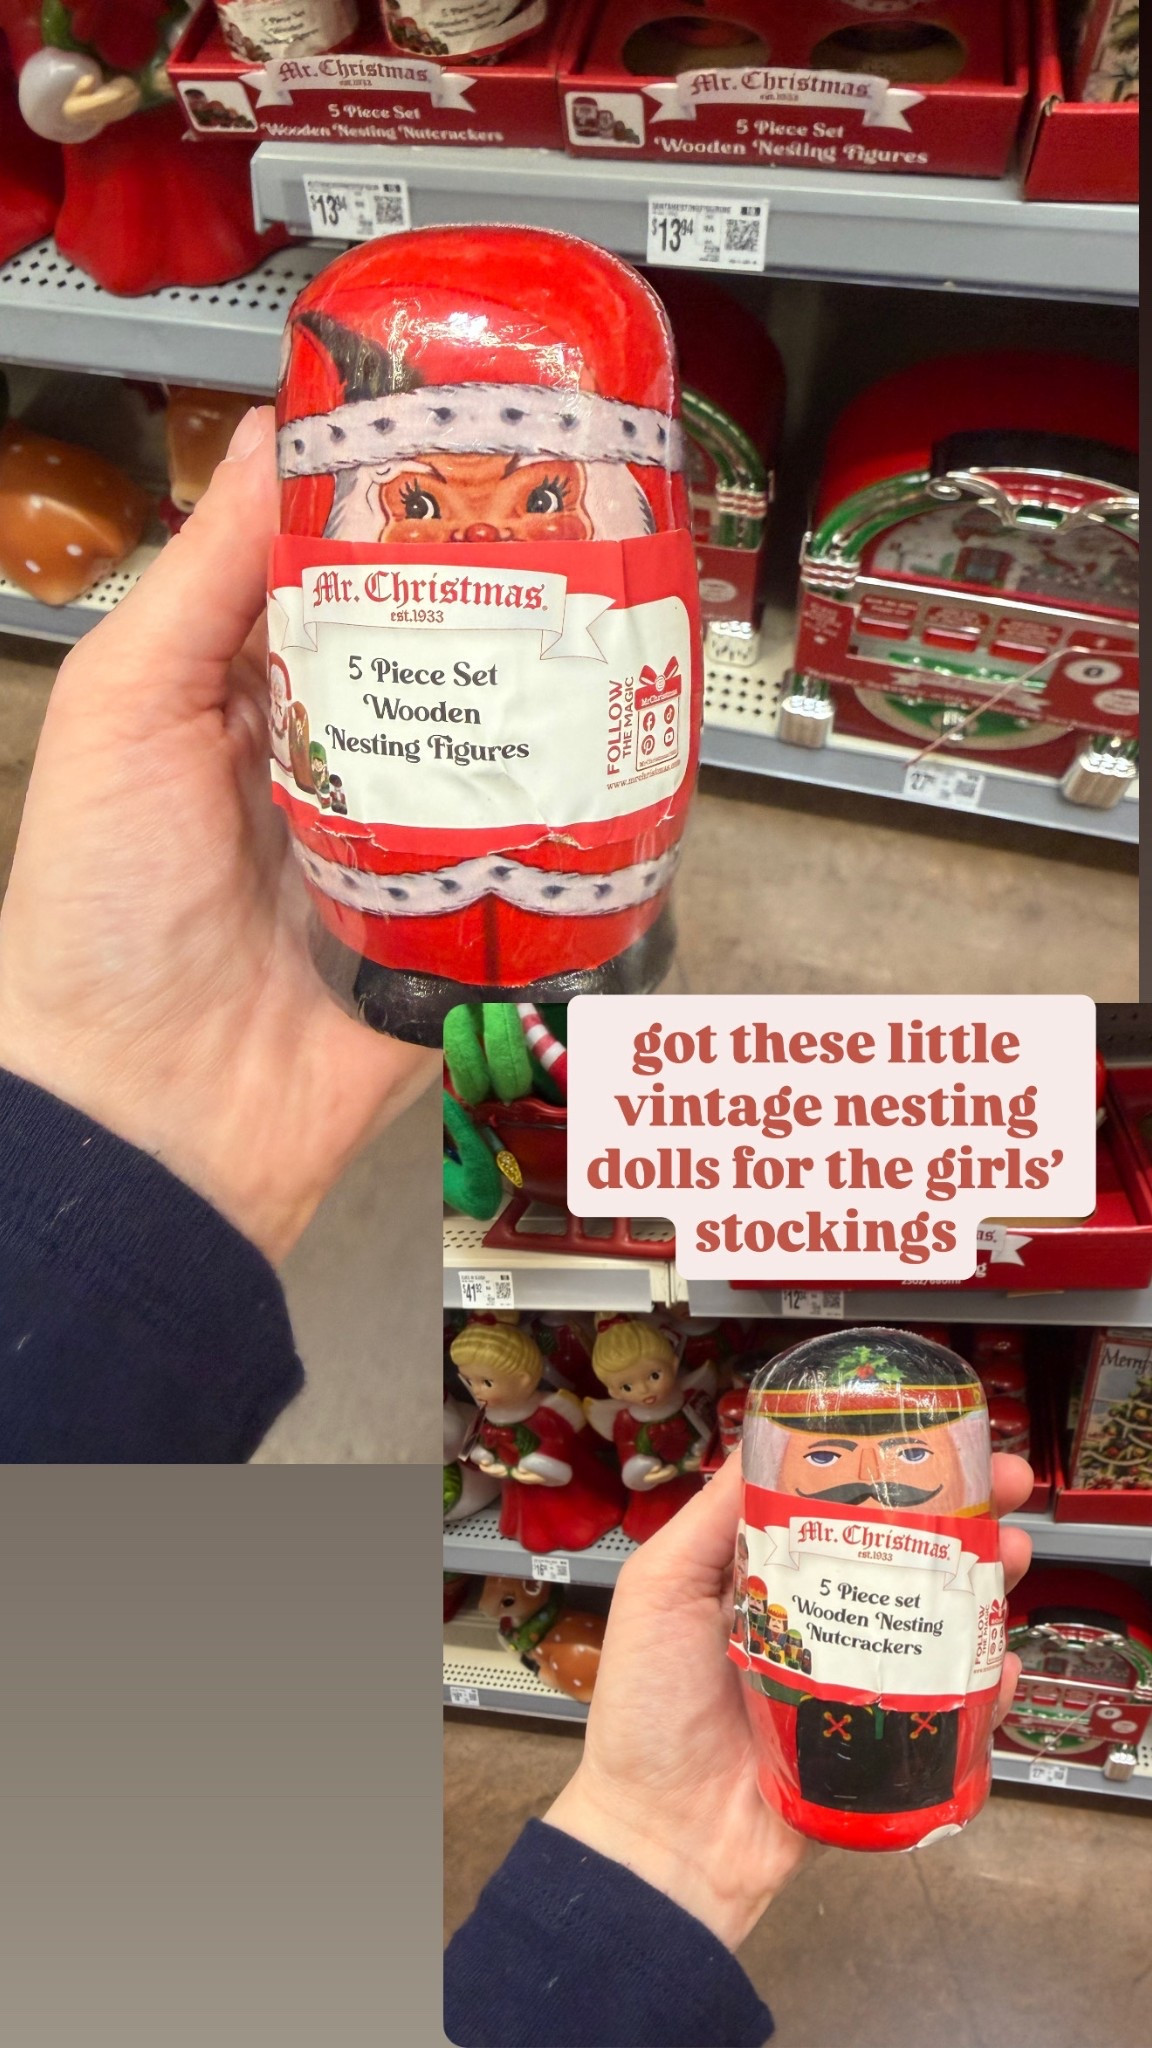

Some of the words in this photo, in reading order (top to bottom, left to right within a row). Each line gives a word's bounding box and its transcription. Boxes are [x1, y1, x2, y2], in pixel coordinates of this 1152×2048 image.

[279, 60, 318, 82] Mr.
[691, 72, 737, 96] Mr.
[328, 103, 340, 118] 5
[343, 104, 390, 119] Piece
[393, 105, 421, 120] Set
[260, 121, 331, 137] Wooden
[332, 122, 397, 140] Nesting
[398, 124, 504, 142] Nutcrackers
[736, 119, 748, 135] 5
[754, 119, 808, 137] Piece
[813, 122, 844, 138] Set
[654, 136, 746, 155] Wooden
[752, 138, 836, 163] Nesting
[843, 143, 928, 165] Figures
[313, 570, 360, 608] Mr.
[390, 609, 444, 623] est.1933
[349, 655, 362, 680] 5
[371, 657, 444, 686] Piece
[453, 661, 498, 687] Set
[363, 693, 481, 725] Wooden
[623, 676, 634, 728] MAGIC
[606, 680, 623, 775] FOLLOW
[325, 724, 421, 764] Nesting
[427, 734, 530, 766] Figures
[622, 730, 632, 759] THE
[798, 1520, 838, 1543] Mr.
[819, 1578, 831, 1596] 5
[837, 1582, 890, 1607] Piece
[895, 1592, 921, 1609] set
[792, 1594, 869, 1627] Wooden
[875, 1611, 944, 1637] Nesting
[806, 1622, 923, 1656] Nutcrackers
[975, 1605, 985, 1665] FOLLOW
